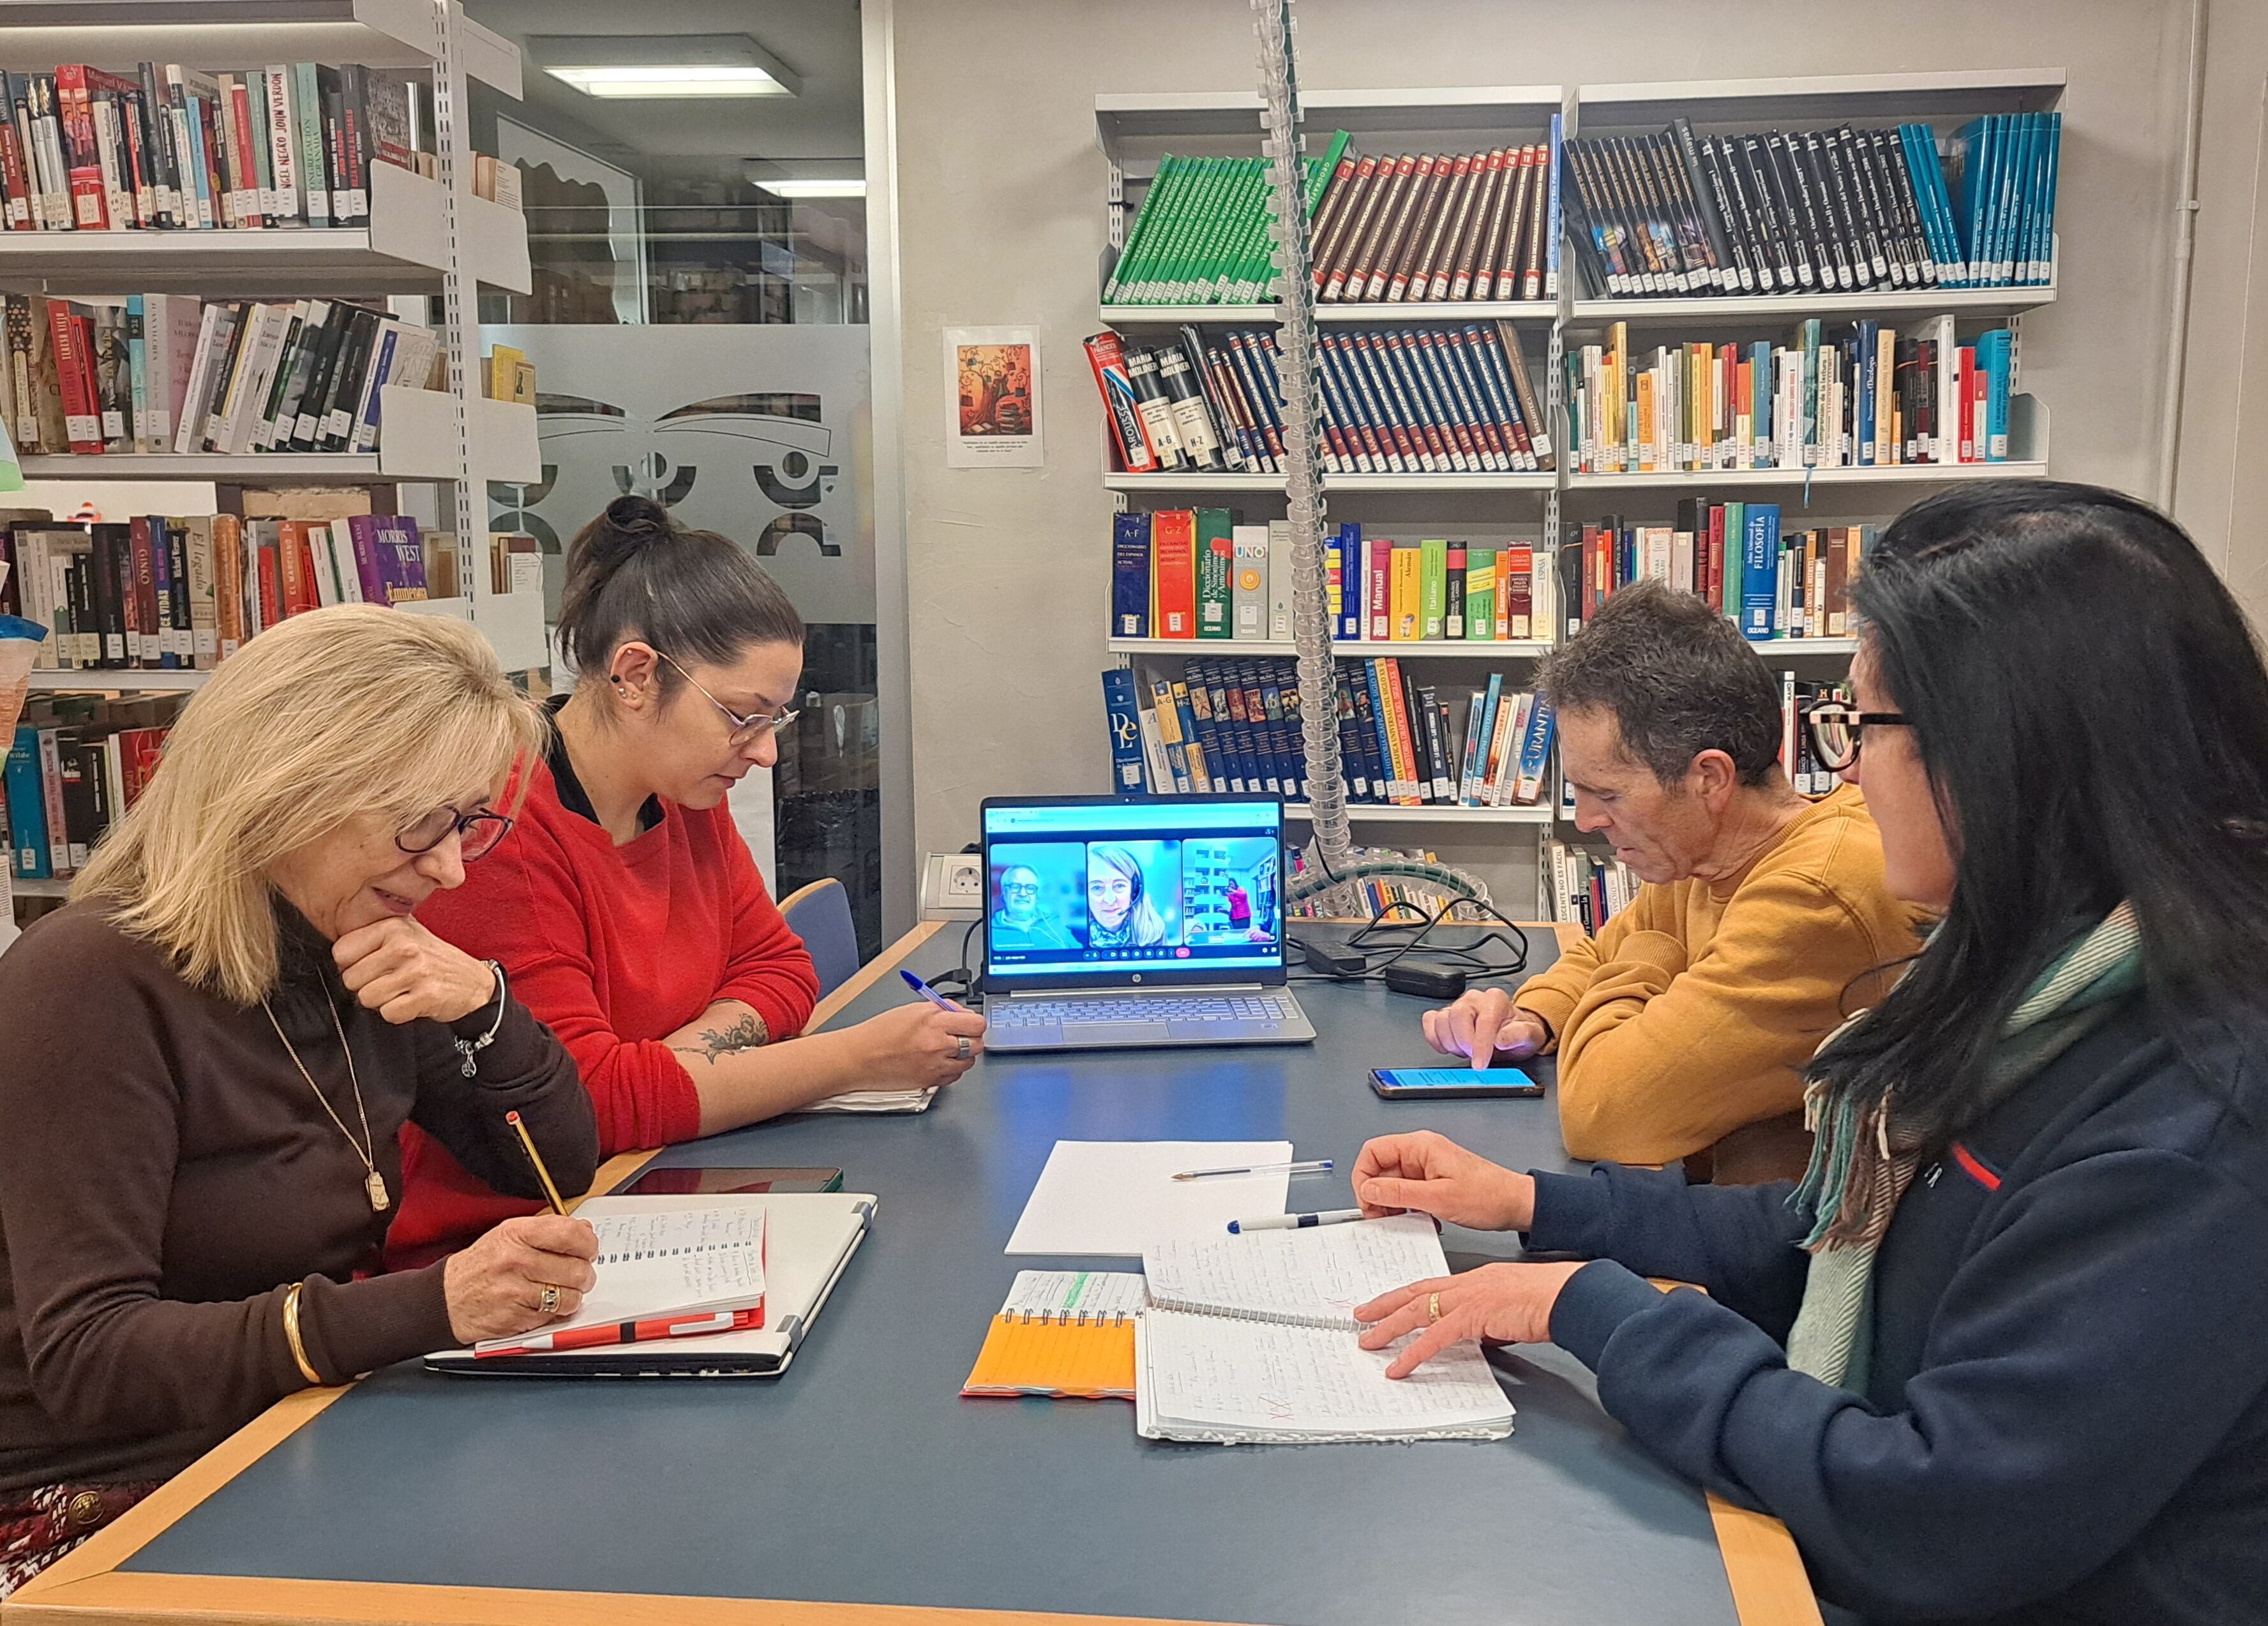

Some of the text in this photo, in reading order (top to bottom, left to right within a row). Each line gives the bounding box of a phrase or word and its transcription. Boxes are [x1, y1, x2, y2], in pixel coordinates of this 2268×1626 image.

[272, 73, 294, 189] NGEL NEGRO JOHN VERDON
[1681, 127, 1695, 155] mayas
[304, 119, 315, 189] ONGREGACIÓN
[313, 131, 322, 177] GRANADA
[1128, 362, 1159, 378] MOLINER
[1160, 362, 1191, 378] MOLINER
[1118, 404, 1140, 450] AROUSSE
[1158, 436, 1172, 447] A-G
[1190, 436, 1205, 447] H-Z
[377, 529, 408, 543] MORRIS
[1165, 526, 1181, 534] G-Z
[395, 544, 420, 562] WEST
[1234, 546, 1266, 558] UNO
[1754, 516, 1765, 569] FILOSOFÍA
[139, 548, 150, 585] GINKO
[192, 532, 207, 590] El legado
[1202, 549, 1212, 599] Diccionario
[1213, 589, 1218, 599] de
[1372, 569, 1384, 611] Manual
[158, 590, 171, 627] CE VIDAS
[1157, 697, 1171, 705] A-G
[1558, 870, 1563, 878] ES
[1559, 879, 1565, 889] NO
[1559, 889, 1568, 923] ESCENTE
